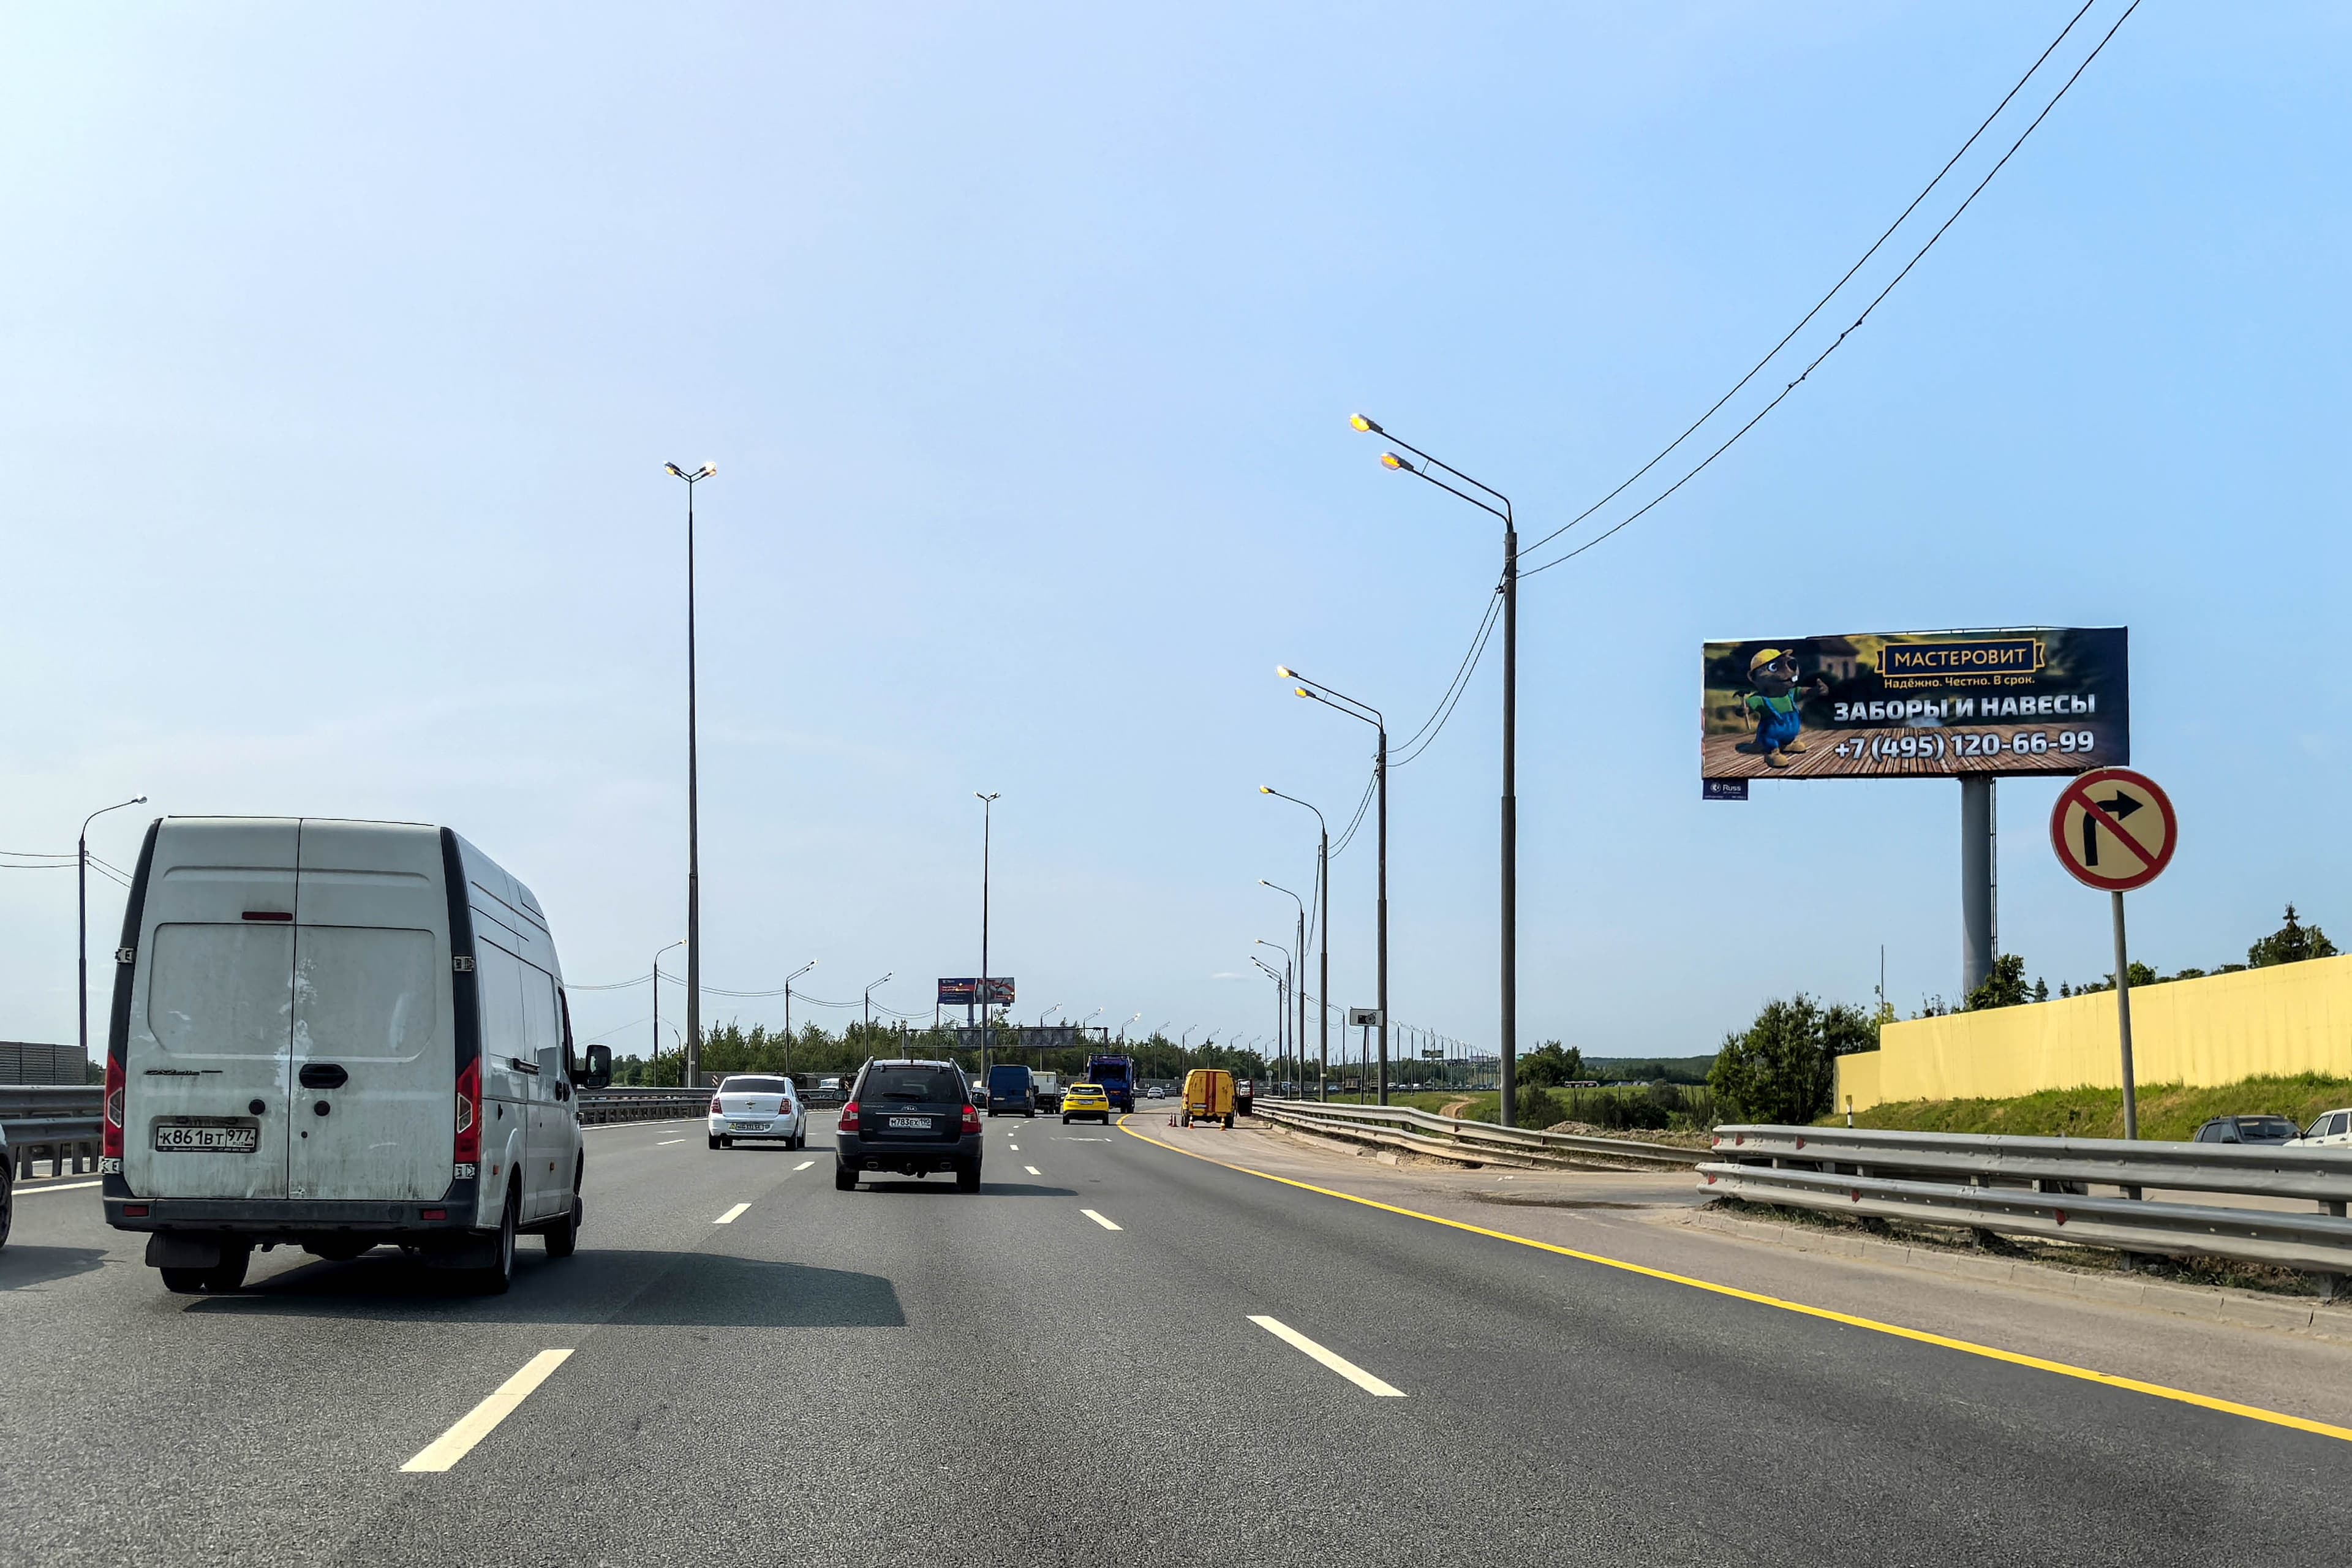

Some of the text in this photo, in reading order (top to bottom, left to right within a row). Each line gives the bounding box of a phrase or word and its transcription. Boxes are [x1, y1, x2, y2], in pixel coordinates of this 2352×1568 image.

[1894, 647, 2027, 667] МАСТЕРОВИТ
[1884, 676, 2035, 689] Надёжно. Честно. В срок.
[1834, 694, 2095, 722] ЗАБОРЫ И НАВЕСЫ
[1834, 731, 2094, 763] +7 (495) 120-66-99
[228, 1129, 252, 1142] 977
